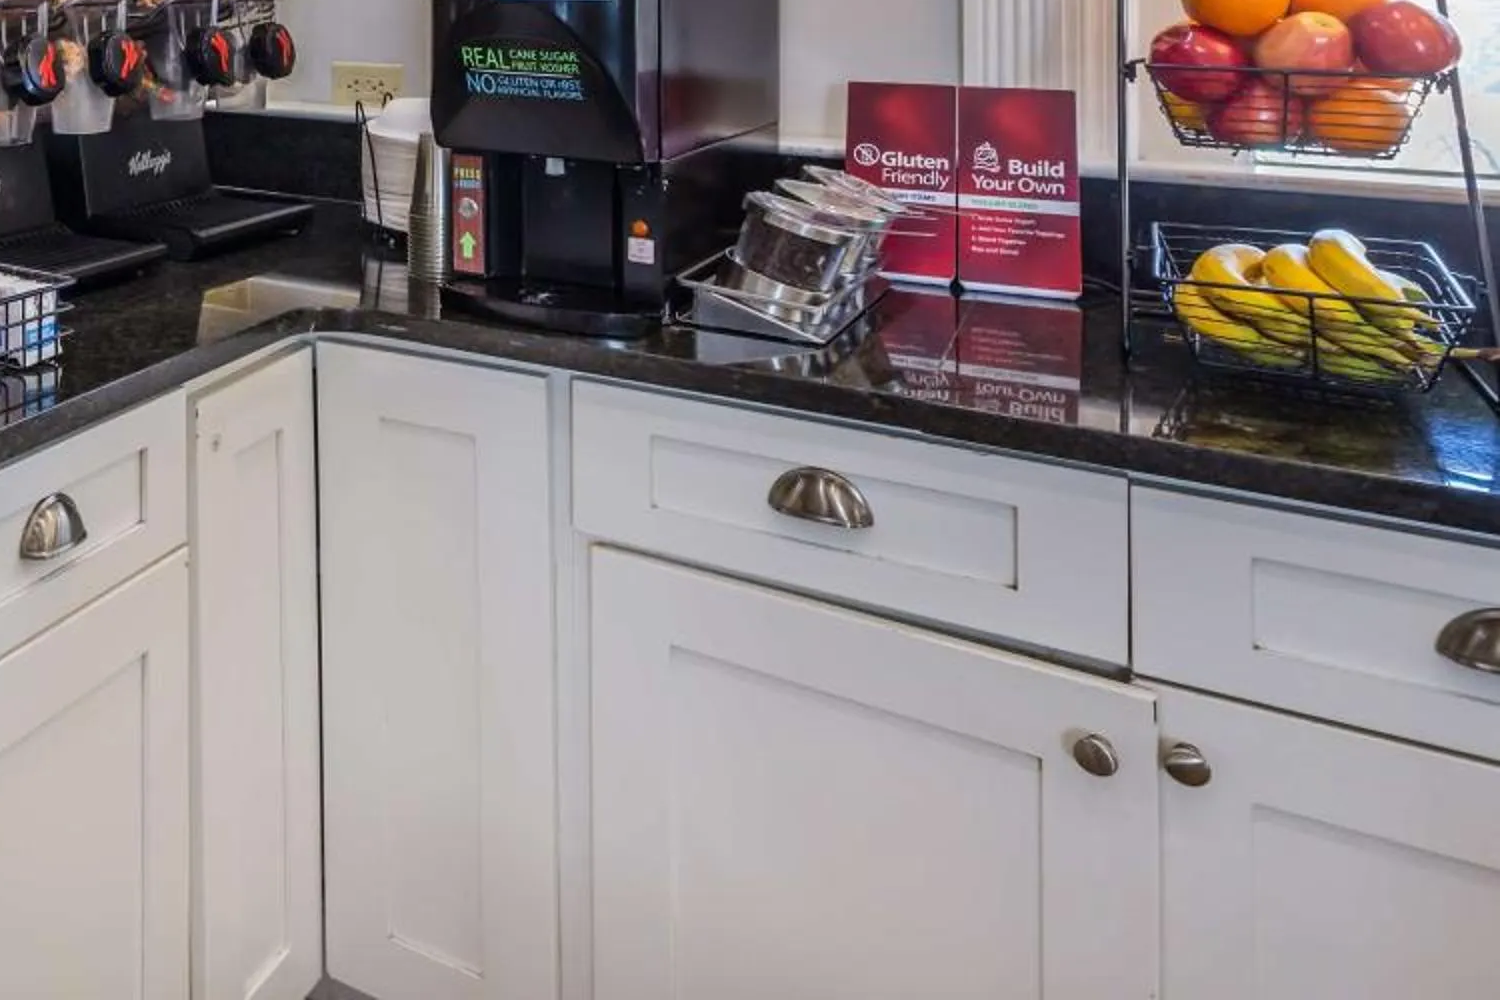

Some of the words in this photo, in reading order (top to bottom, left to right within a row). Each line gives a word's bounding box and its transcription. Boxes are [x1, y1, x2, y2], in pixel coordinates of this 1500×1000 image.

[461, 46, 510, 69] REAL
[509, 48, 537, 60] CANE
[466, 71, 497, 94] NO
[128, 149, 172, 176] Kellogg's
[881, 150, 949, 170] Gluten
[1008, 159, 1065, 177] Build
[881, 167, 949, 190] Friendly
[972, 174, 1016, 192] Your
[1018, 177, 1065, 195] Own
